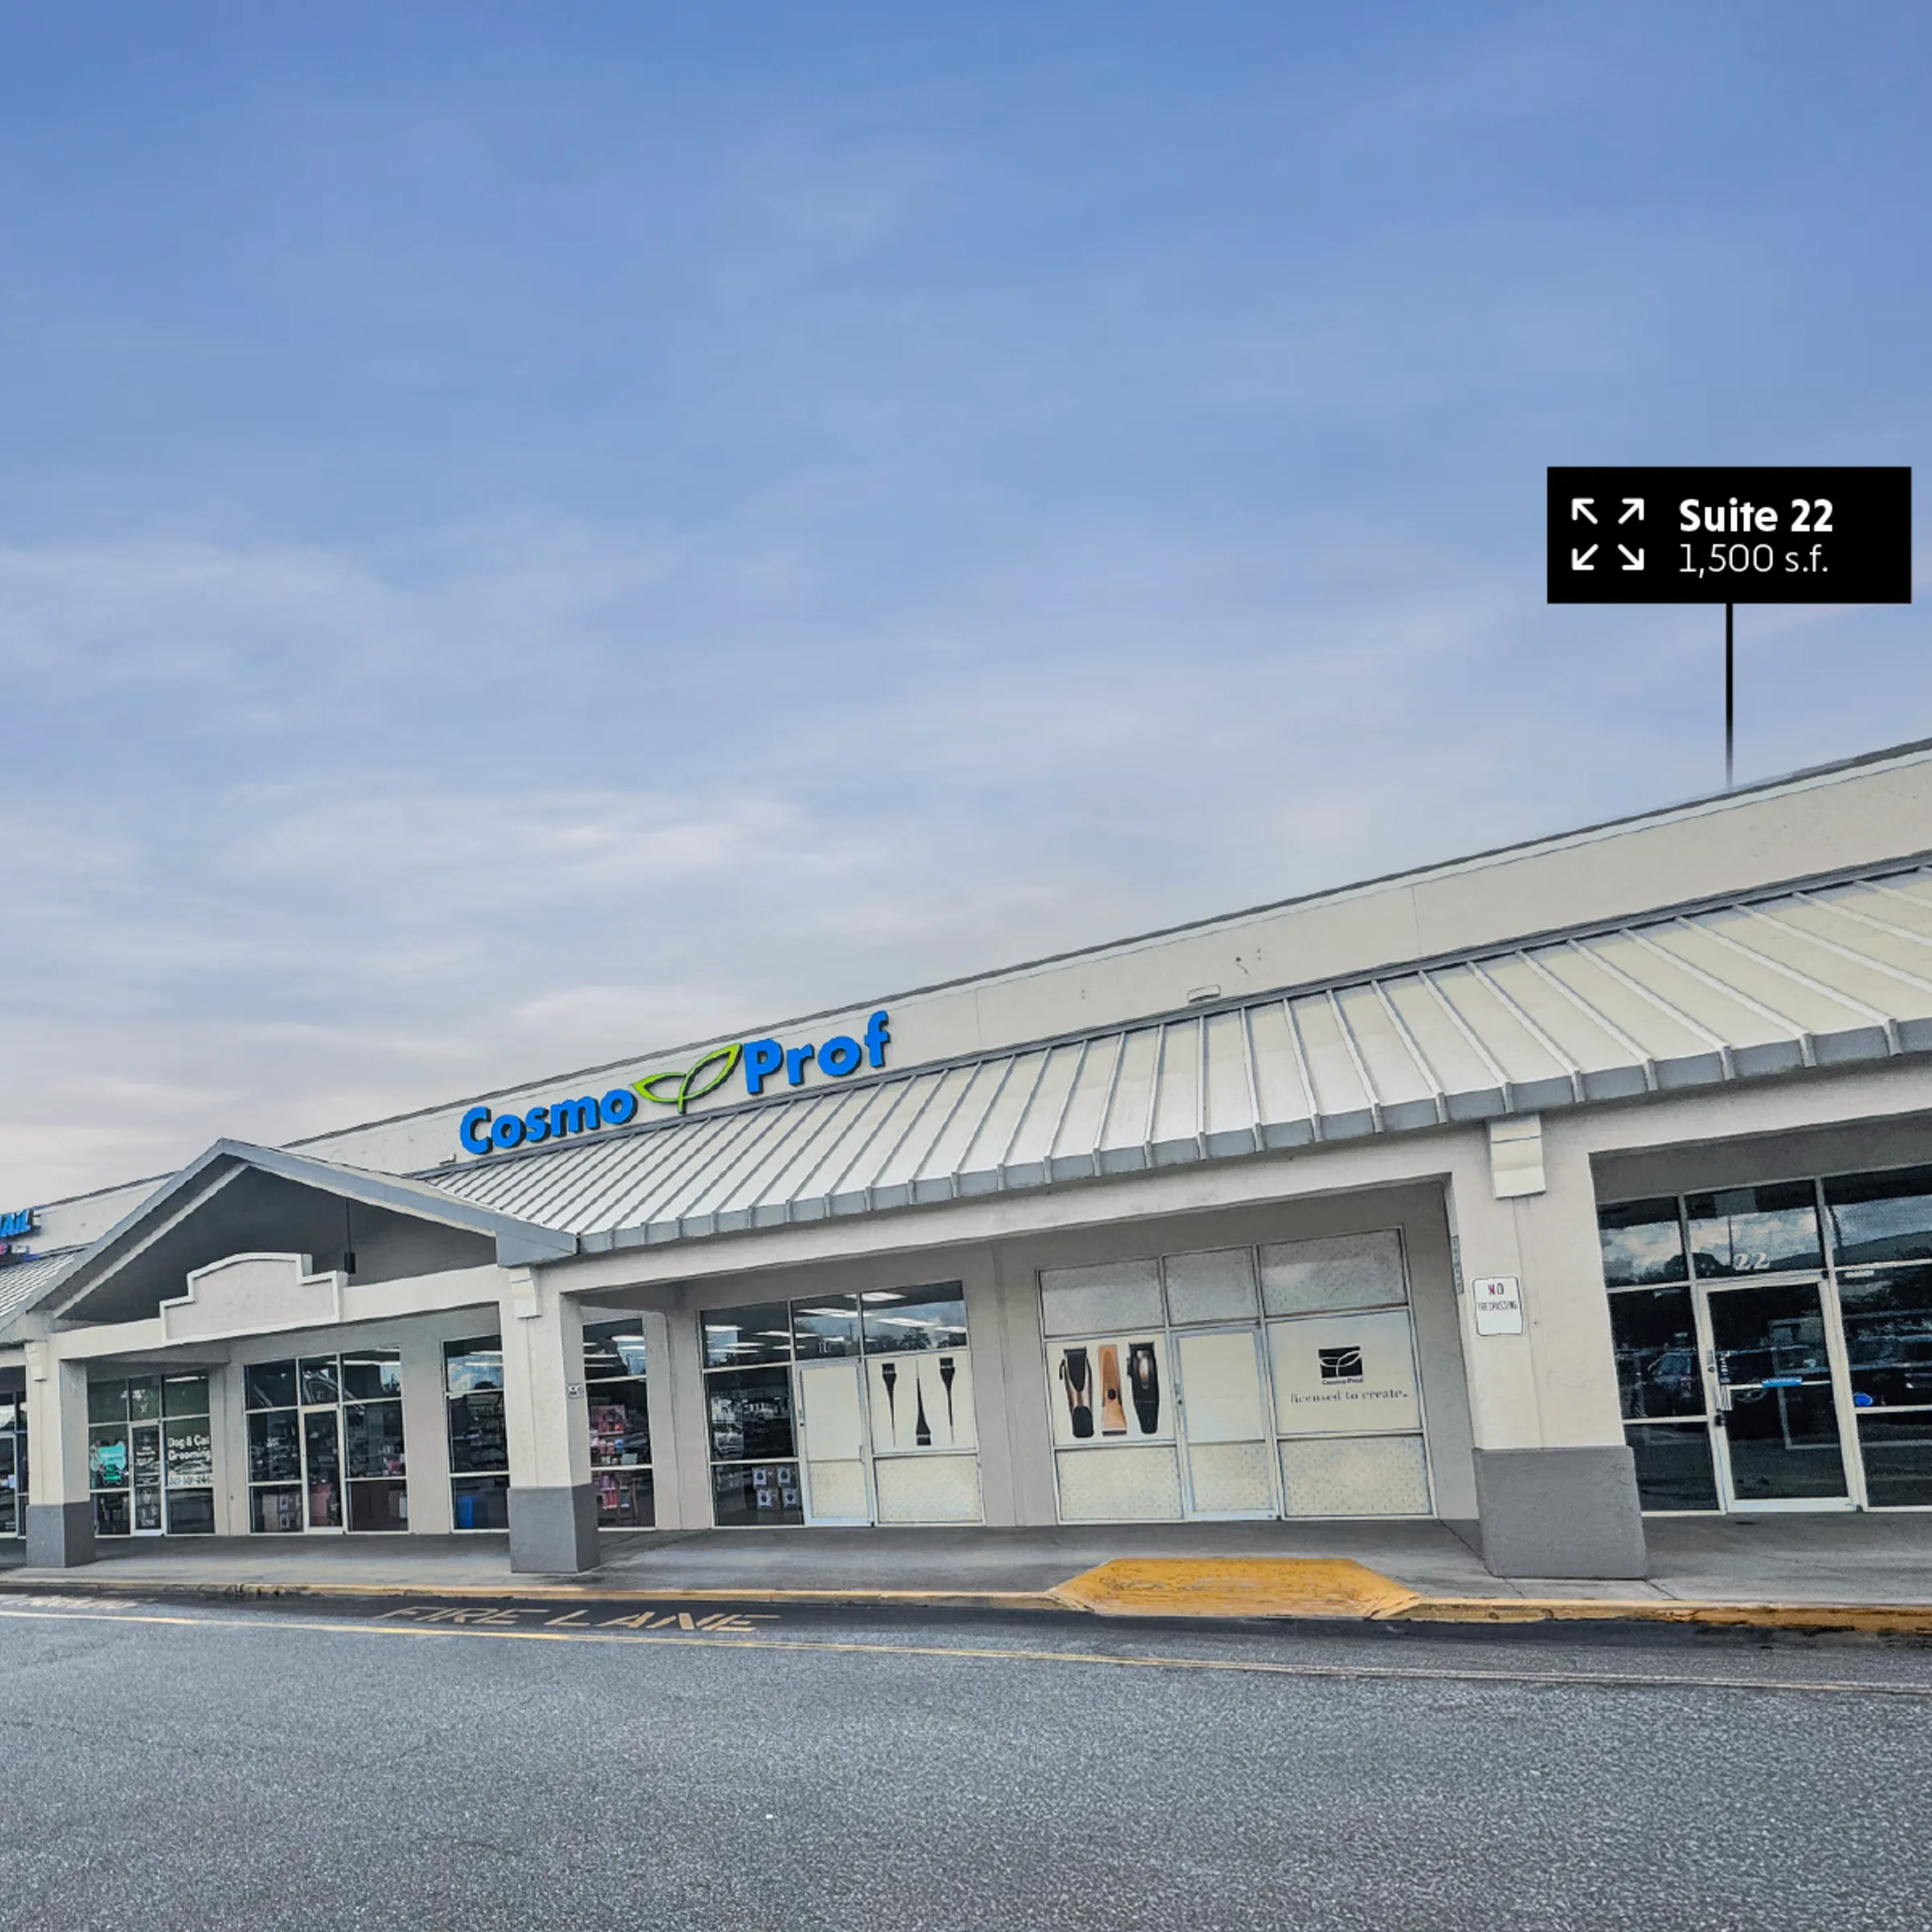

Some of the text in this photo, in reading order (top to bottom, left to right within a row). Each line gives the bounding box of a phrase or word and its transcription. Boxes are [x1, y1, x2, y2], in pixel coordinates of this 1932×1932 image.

[460, 1010, 891, 1154] Cosmo Prof
[1733, 1252, 1770, 1270] 22
[1488, 1282, 1505, 1295] NO
[1290, 1389, 1342, 1404] licensed
[1346, 1391, 1358, 1400] to
[167, 1437, 185, 1449] Dog
[168, 1447, 211, 1461] Grooming
[375, 1606, 781, 1632] FIRE LANE
